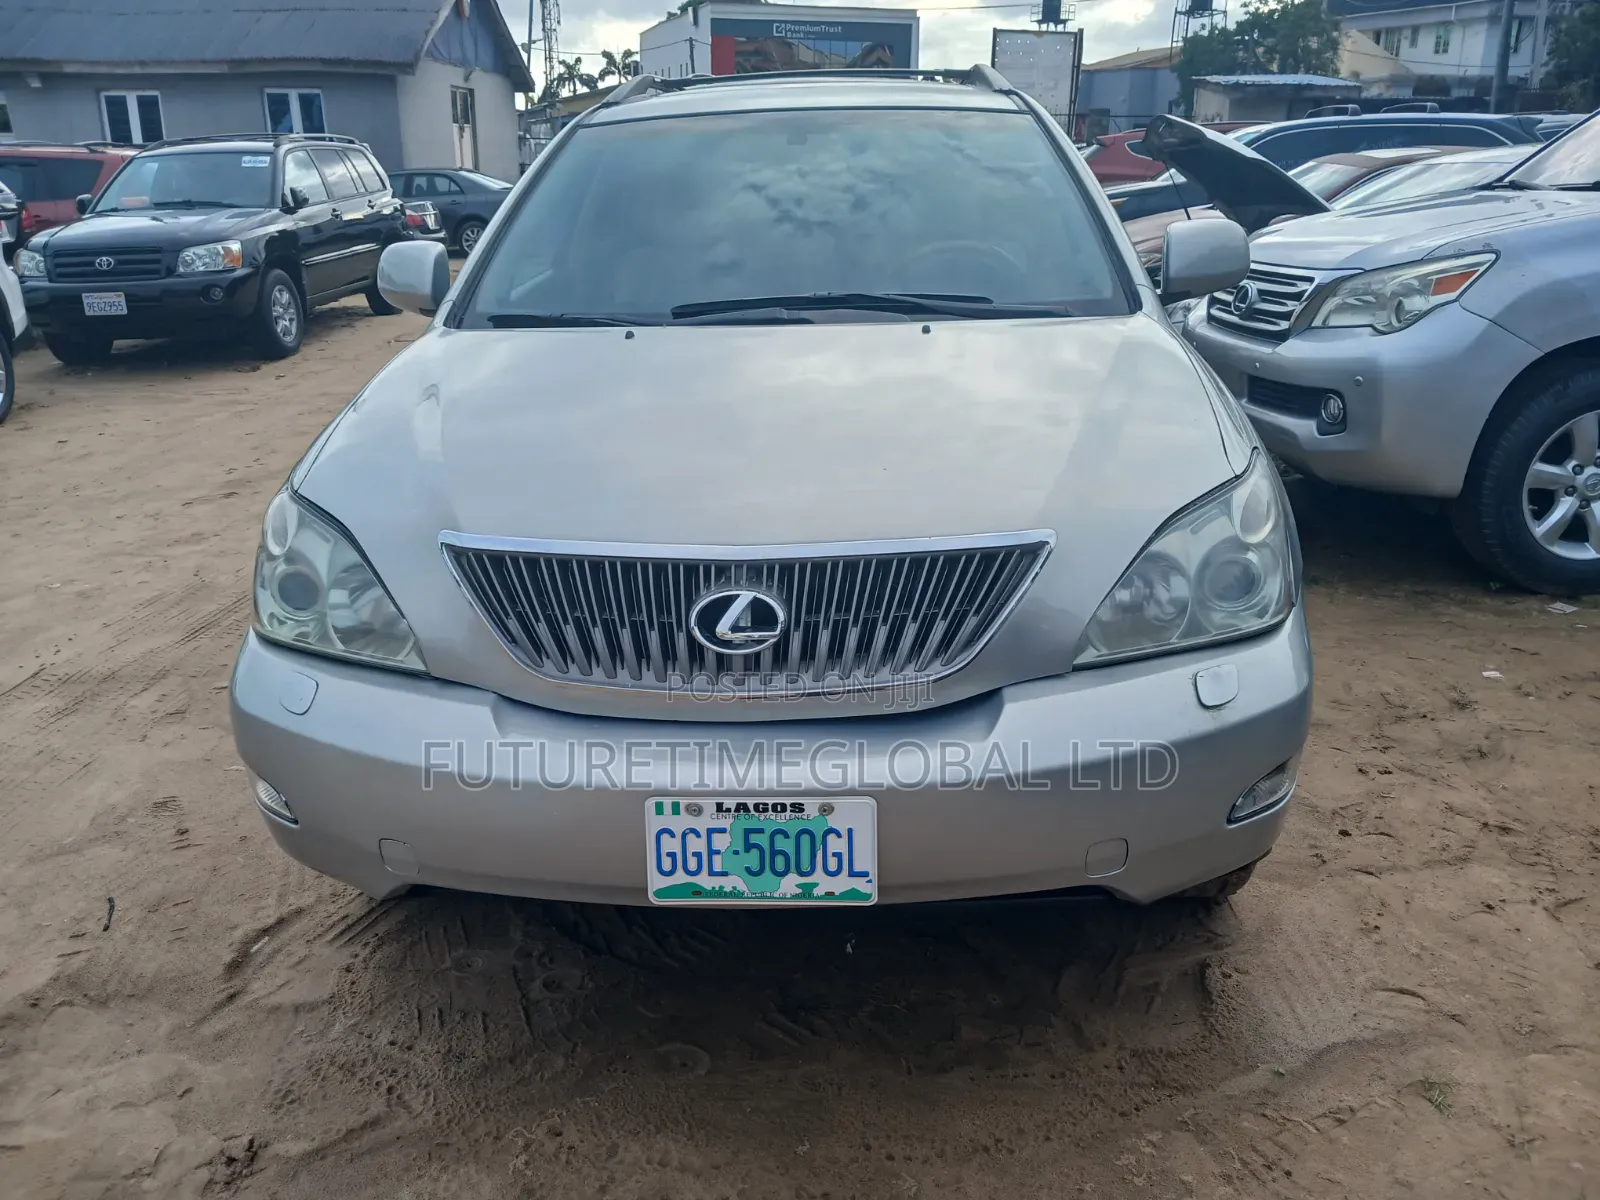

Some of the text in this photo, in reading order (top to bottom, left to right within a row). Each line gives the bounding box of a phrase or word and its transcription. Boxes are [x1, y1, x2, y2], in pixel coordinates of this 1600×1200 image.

[785, 23, 842, 33] PremiumTrust
[86, 301, 124, 312] 9EGZ955
[715, 802, 805, 813] LAGOS
[655, 827, 870, 877] GGE-560GL
